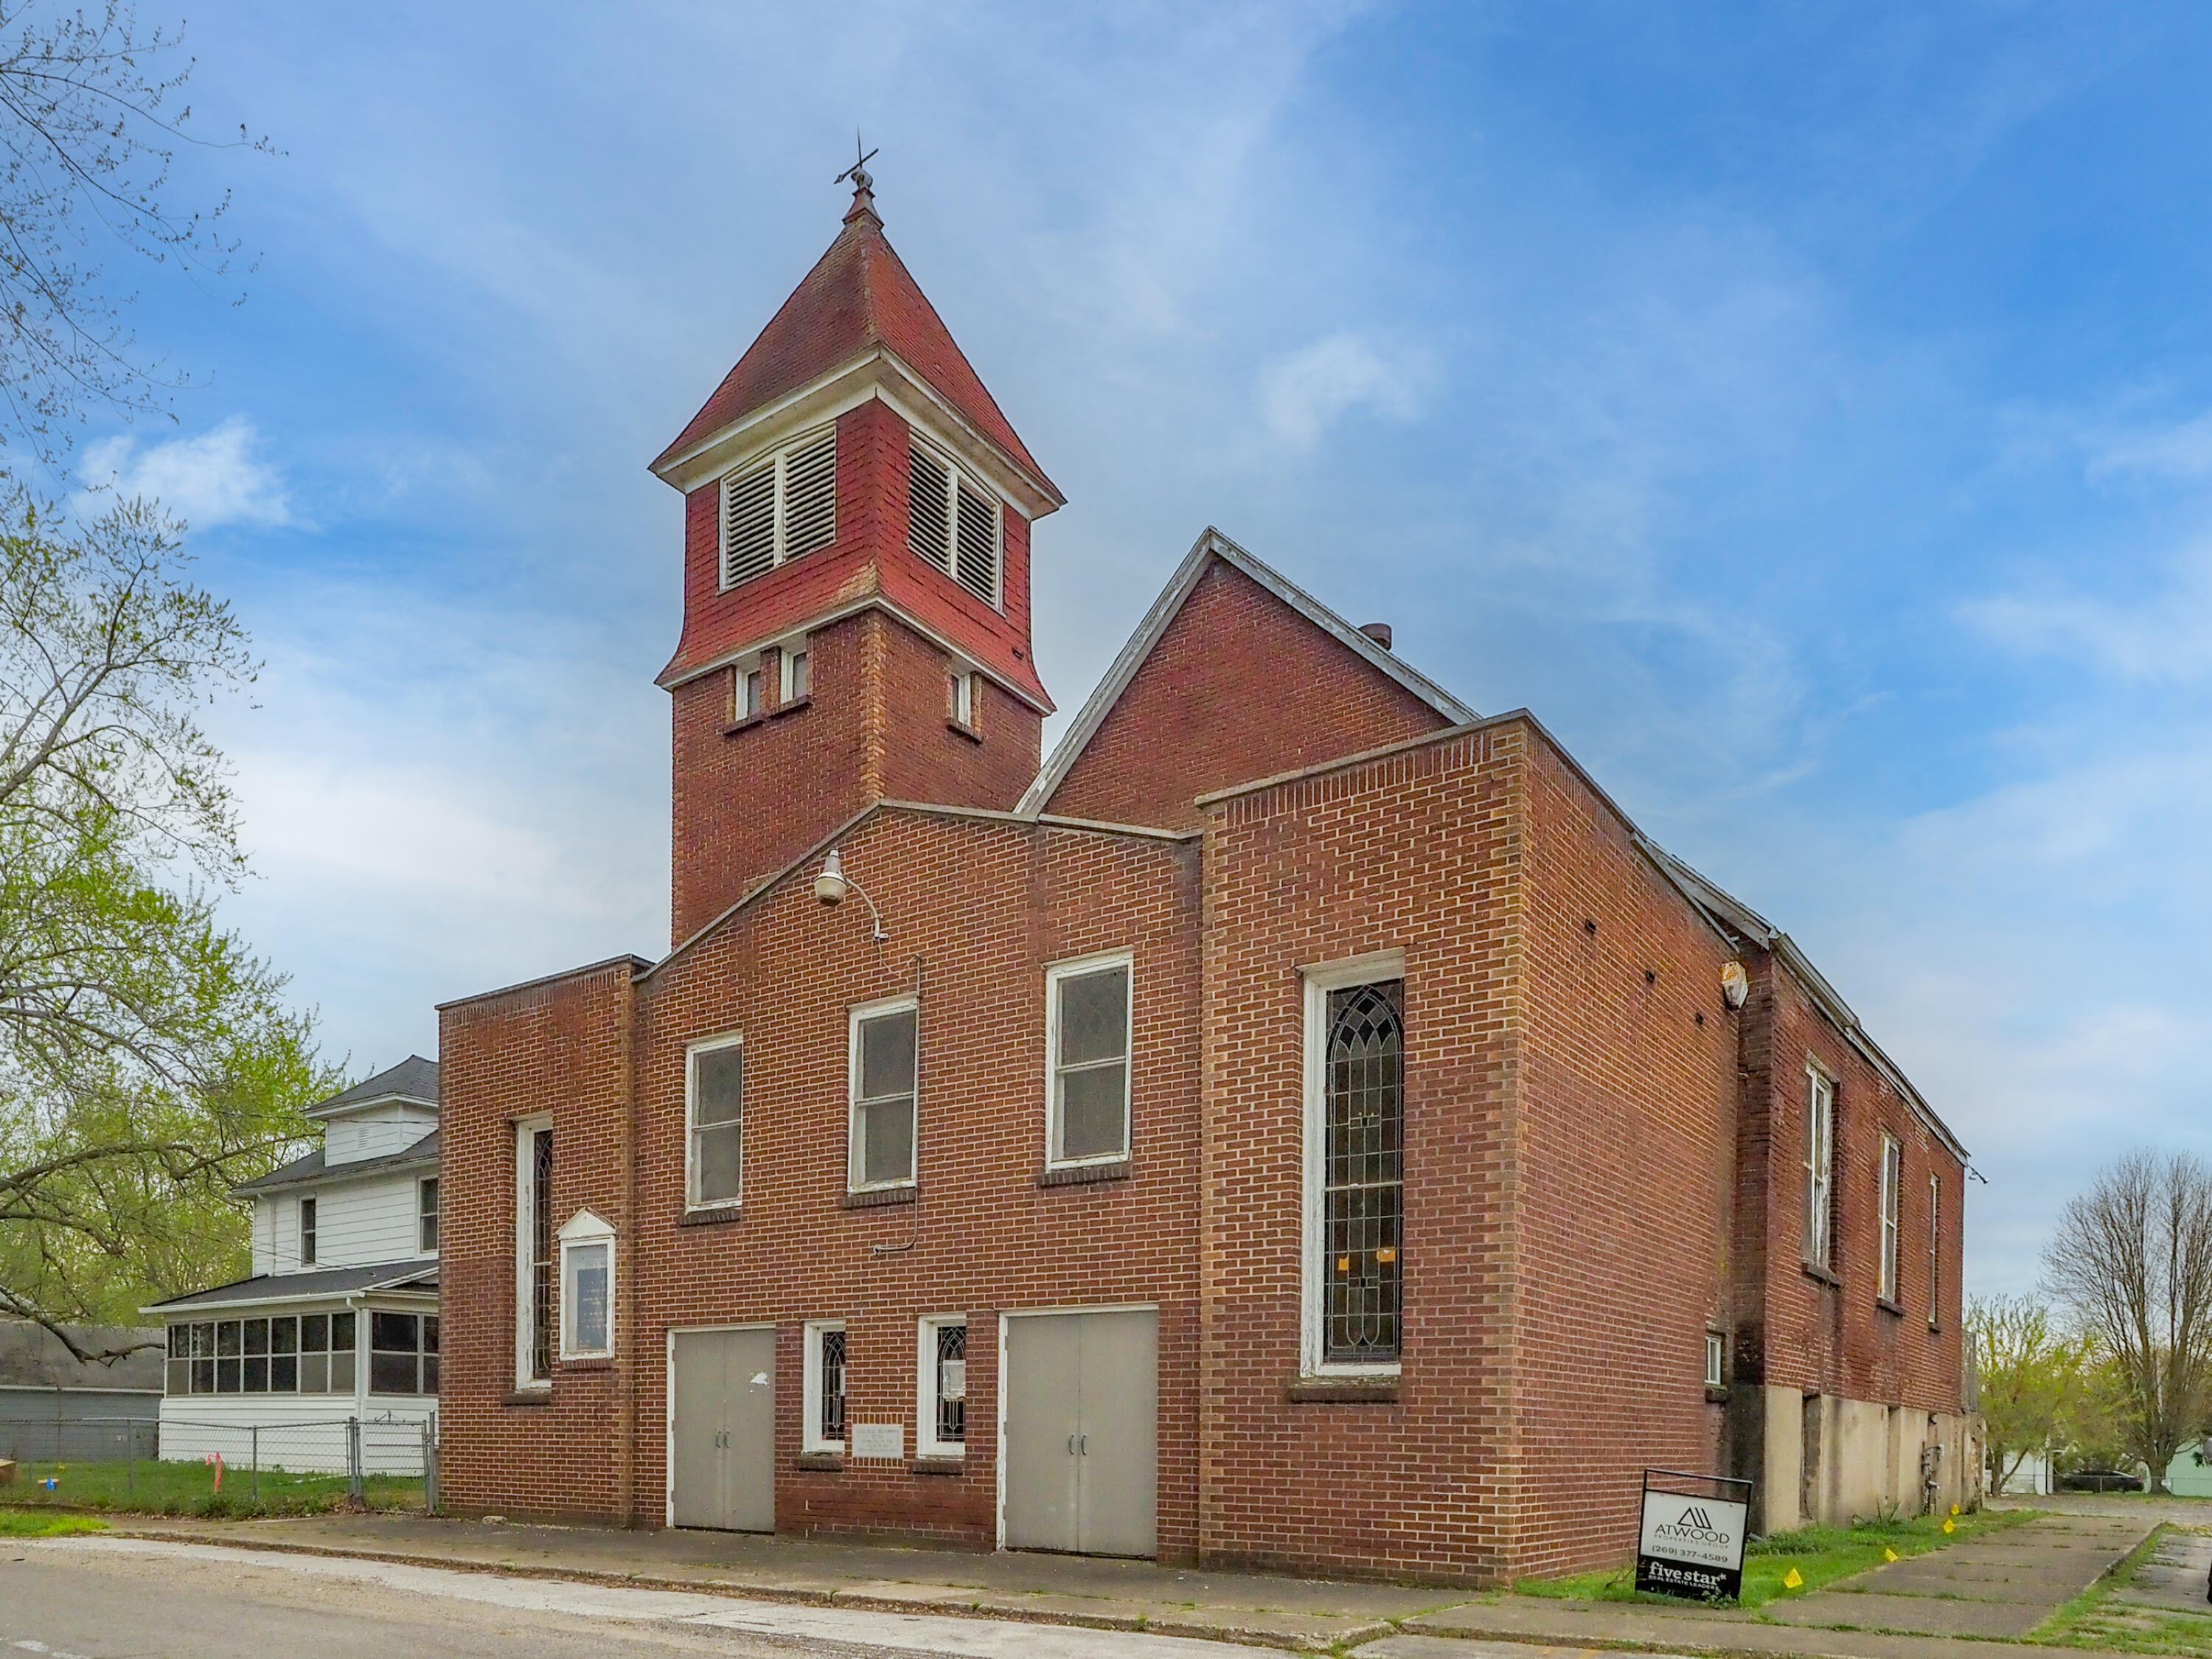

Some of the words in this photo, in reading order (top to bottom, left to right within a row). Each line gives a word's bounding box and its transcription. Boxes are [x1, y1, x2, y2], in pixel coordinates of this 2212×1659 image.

[1654, 1534, 1699, 1544] PROPERTIES
[1702, 1541, 1729, 1549] GROUP
[1655, 1524, 1730, 1544] ATWOOD
[1652, 1545, 1677, 1556] (269)
[1680, 1549, 1728, 1563] 377-4589
[1649, 1561, 1682, 1579] five
